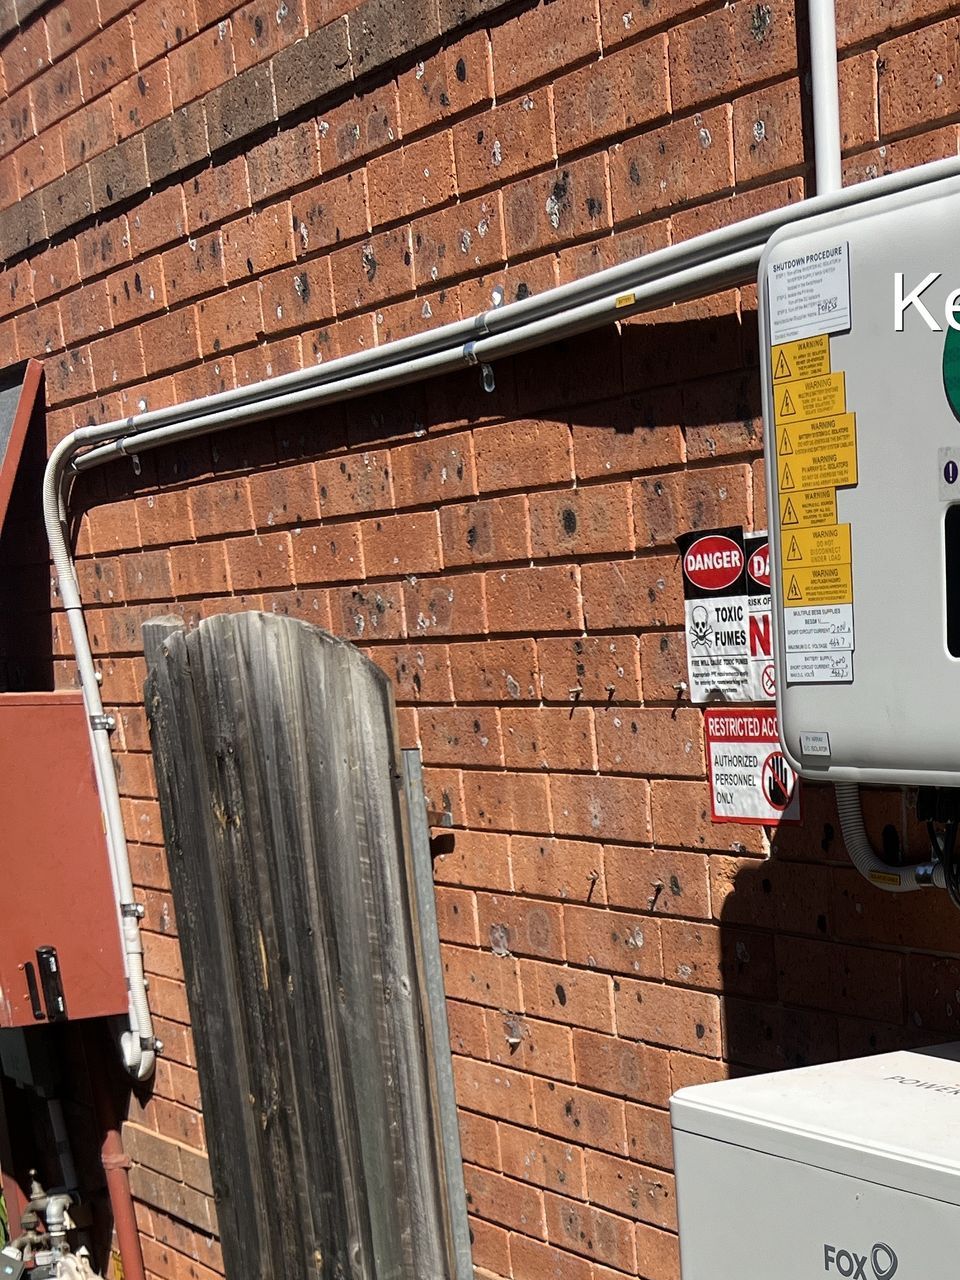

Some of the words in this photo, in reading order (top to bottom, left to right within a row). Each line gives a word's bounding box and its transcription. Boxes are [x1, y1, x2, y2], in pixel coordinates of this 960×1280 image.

[773, 258, 805, 273] SHUTDOWN
[806, 246, 842, 264] PROCEDURE
[797, 338, 823, 350] WARNING
[805, 379, 832, 390] WARNING
[811, 420, 835, 430] WARNING
[812, 454, 837, 464] WARNING
[805, 490, 830, 500] WARNING
[812, 530, 838, 539] WARNING
[687, 550, 741, 572] DANGER
[812, 569, 838, 577] WARNING
[748, 598, 762, 606] RISK
[715, 606, 743, 623] TOXIC
[715, 629, 746, 647] FUMES
[708, 717, 760, 736] RESTRICTED
[714, 755, 758, 768] AUTHORIZED
[715, 774, 756, 786] PERSONNEL
[717, 792, 734, 804] ONLY
